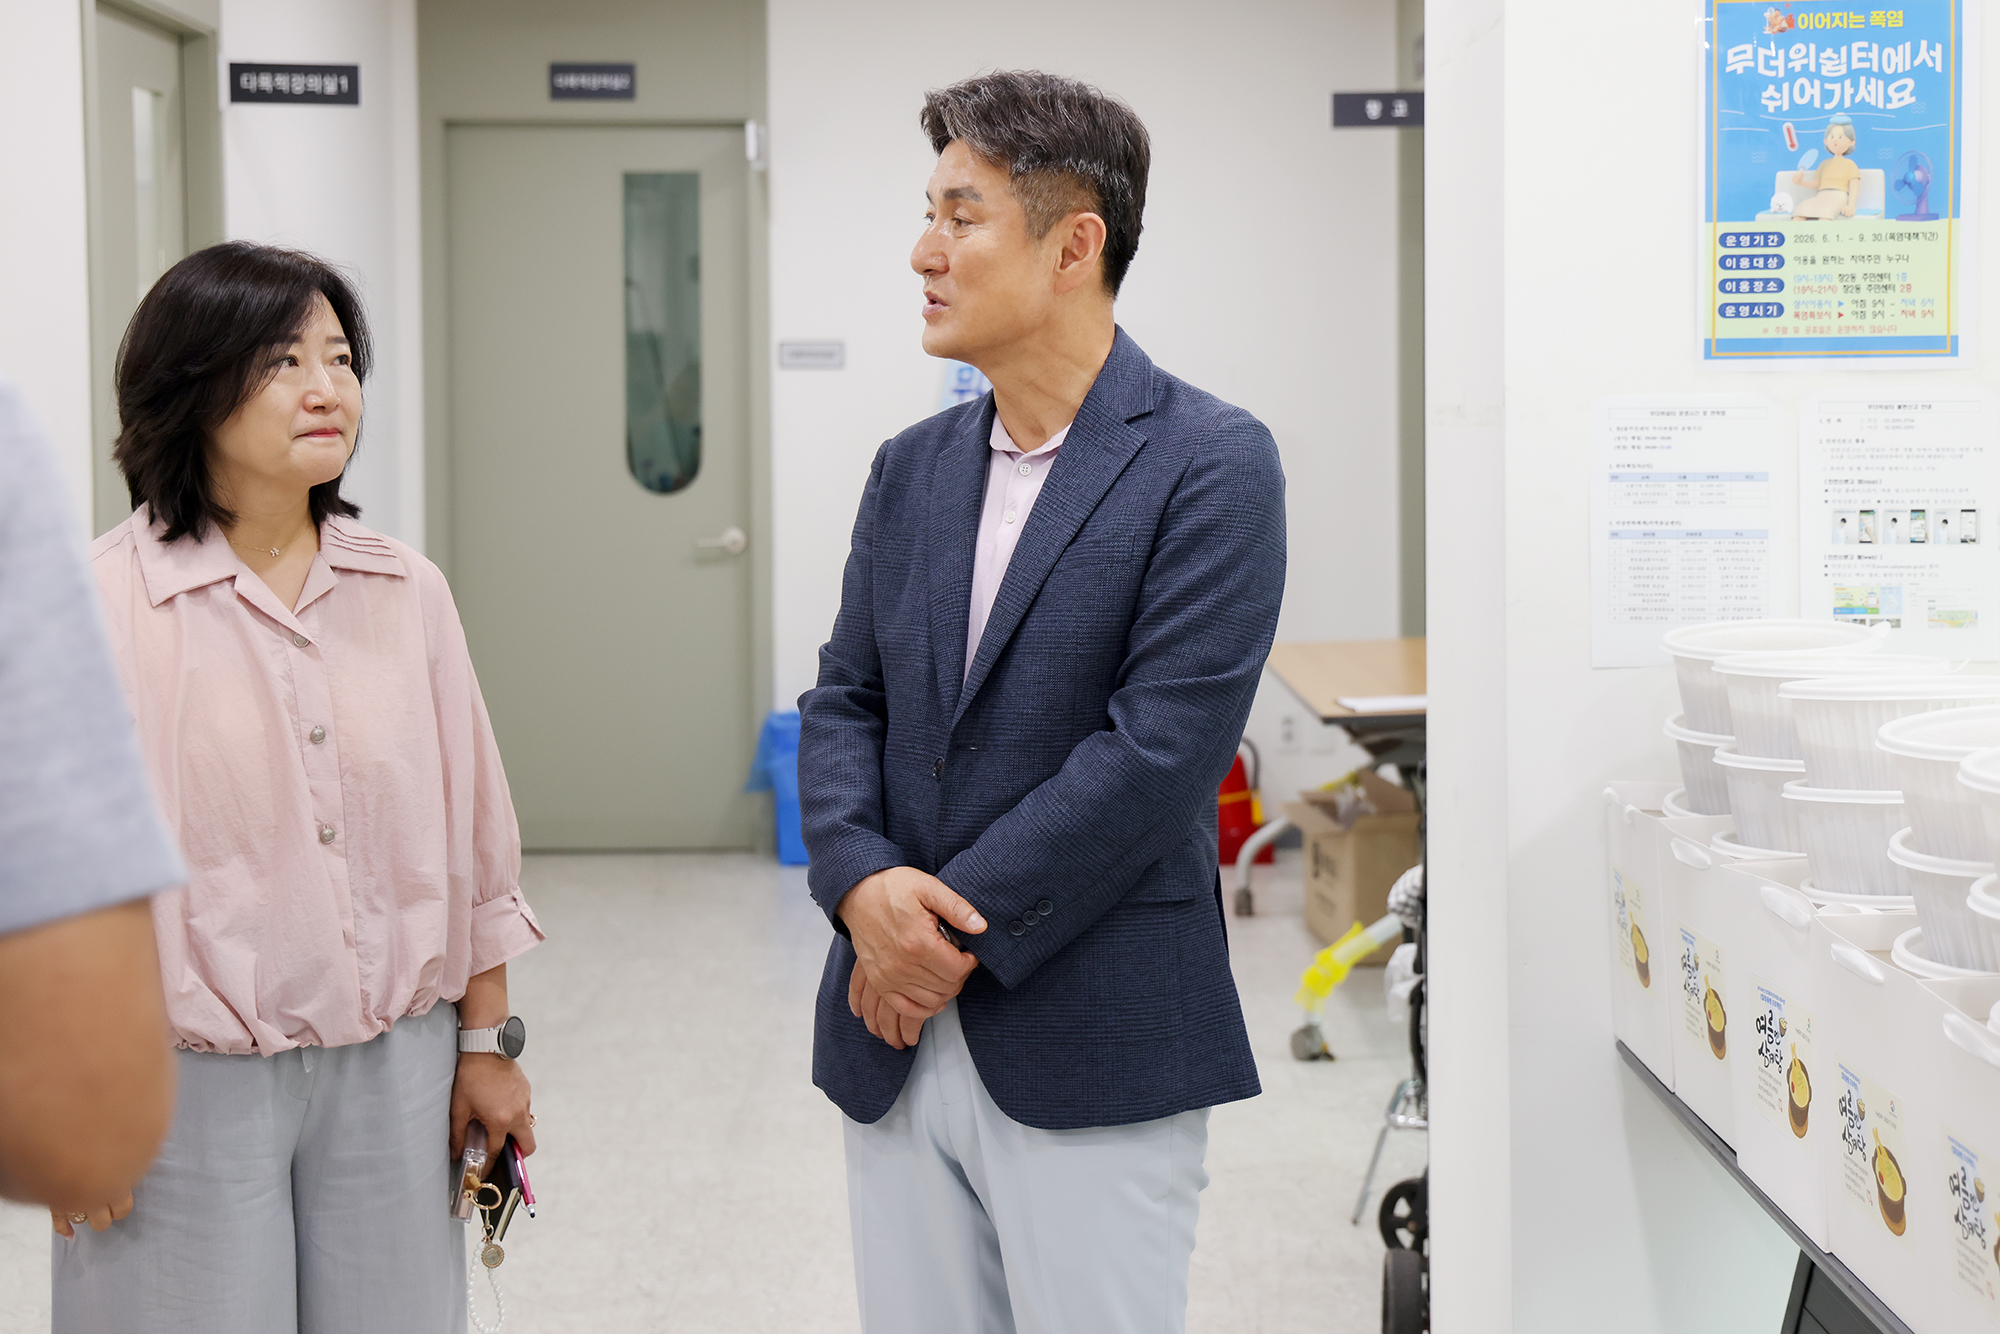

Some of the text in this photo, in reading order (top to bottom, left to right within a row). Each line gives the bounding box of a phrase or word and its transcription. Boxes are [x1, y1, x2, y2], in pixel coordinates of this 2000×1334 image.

[1797, 10, 1904, 29] 이어지는 폭염
[1725, 39, 1943, 78] 무더위쉼터에서
[1761, 76, 1916, 113] 쉬어가세요
[1725, 234, 1779, 247] 운영기간
[1725, 257, 1778, 269] 이용대상
[1725, 280, 1778, 292] 이용장소
[1725, 305, 1778, 317] 운영시기
